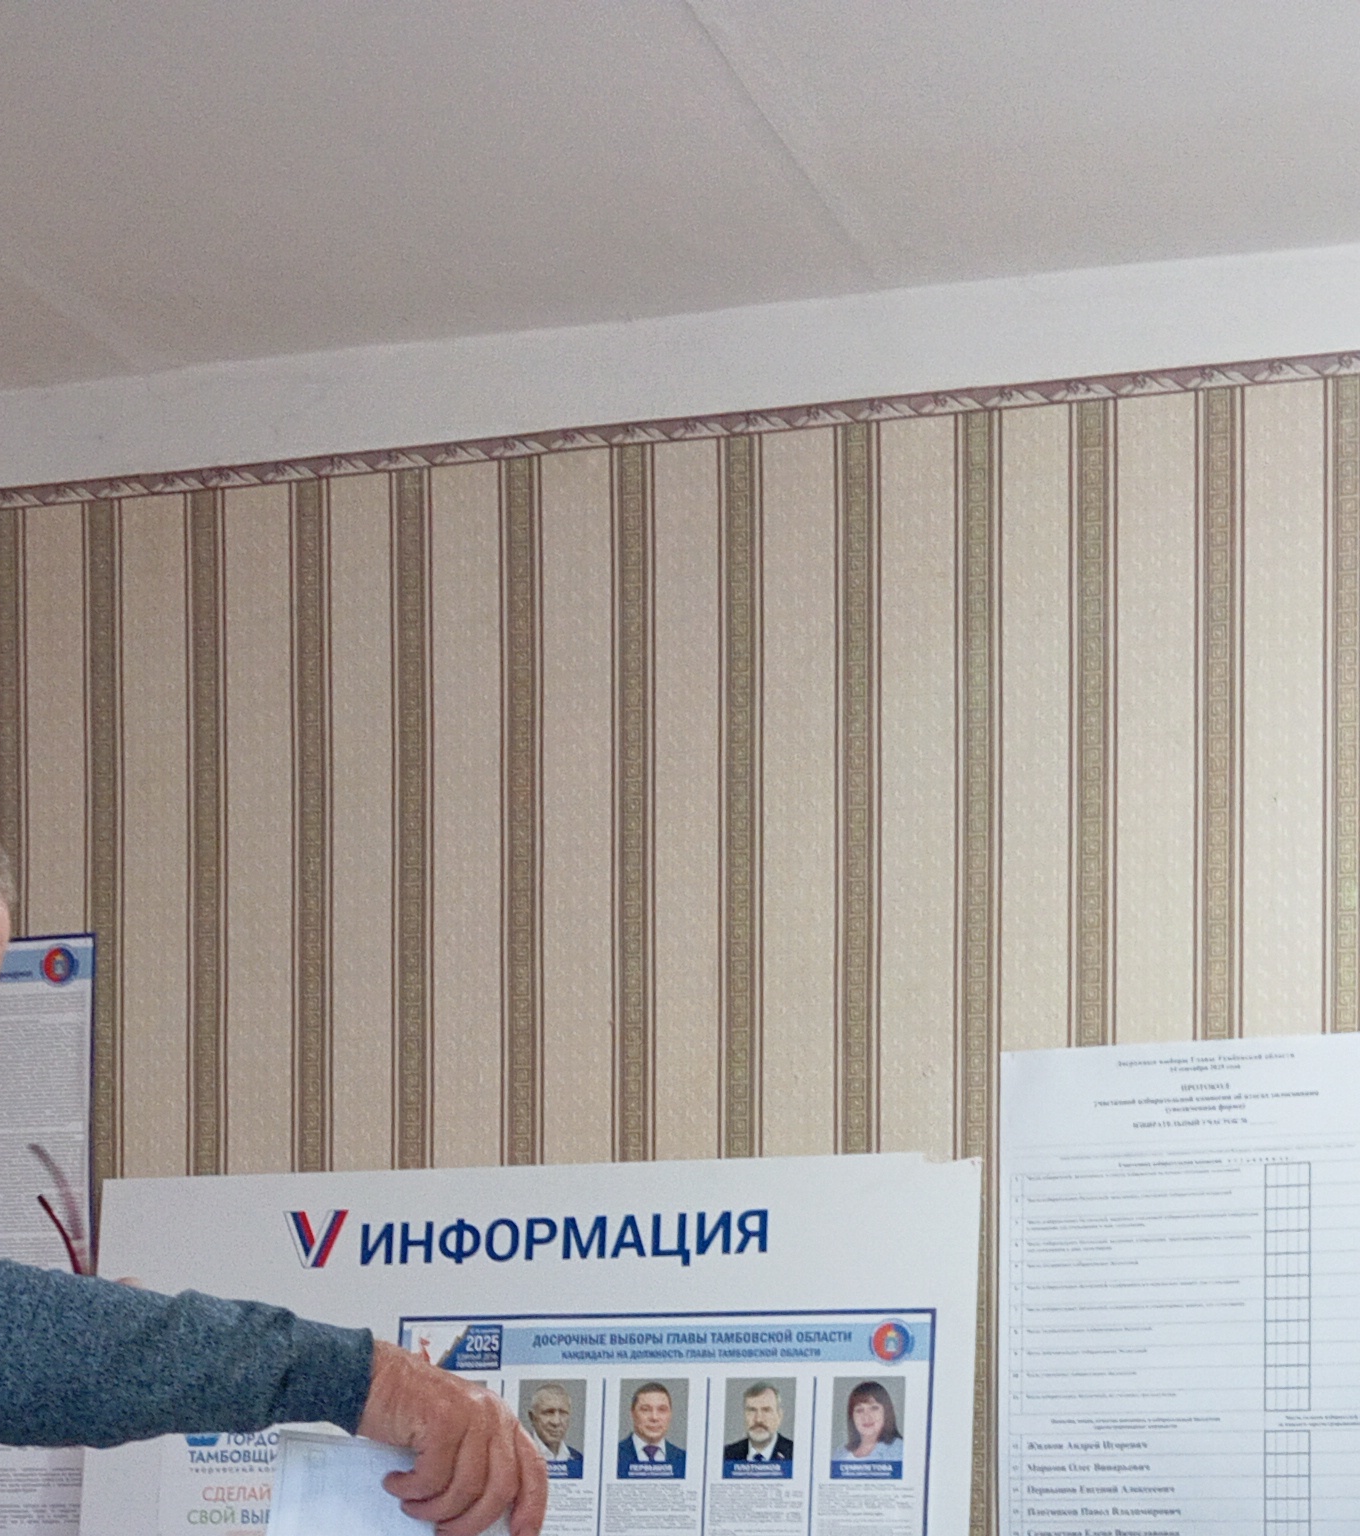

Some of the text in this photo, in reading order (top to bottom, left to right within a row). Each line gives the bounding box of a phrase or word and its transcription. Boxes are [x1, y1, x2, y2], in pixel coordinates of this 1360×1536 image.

[360, 1209, 768, 1267] ИНФОРМАЦИЯ
[466, 1334, 500, 1352] 2025
[532, 1329, 853, 1348] ДОСРОЧНЫЕ ВЫБОРЫ ГЛАВЫ ТАМБОВСКОЙ ОБЛАСТИ
[562, 1347, 821, 1360] КАНДИДАТЫ НА ДОЛЖНОСТЬ ГЛАВЫ ТАМБОВСКОЙ ОБЛАСТИ
[202, 1483, 271, 1503] СДЕЛАЙ
[187, 1505, 236, 1525] СВОЙ
